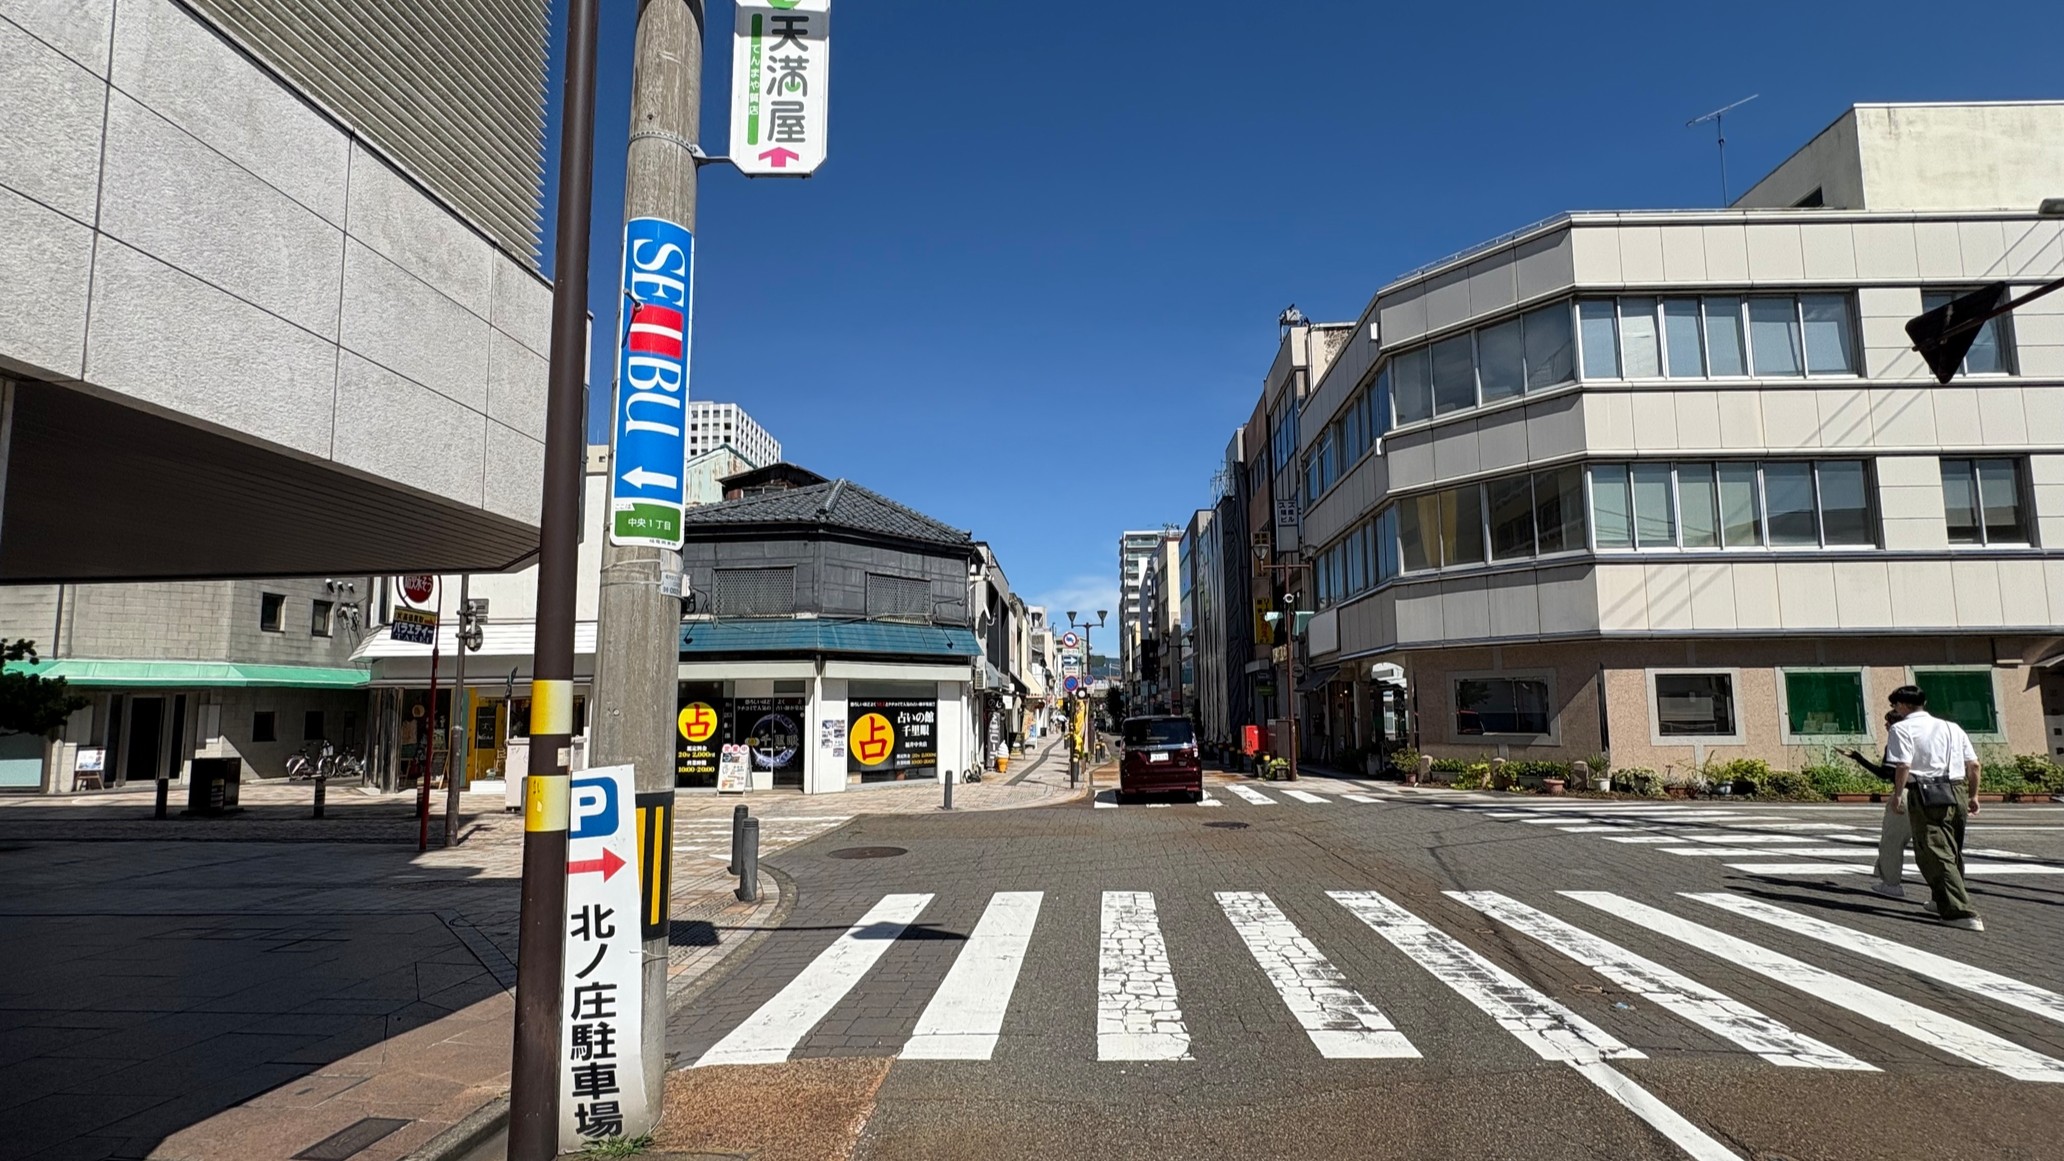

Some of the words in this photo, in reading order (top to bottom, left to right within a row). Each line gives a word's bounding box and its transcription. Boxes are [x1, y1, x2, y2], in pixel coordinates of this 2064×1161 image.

[748, 44, 761, 115] てんまや質店
[766, 15, 810, 144] 天満屋
[626, 238, 686, 438] SEIBU
[685, 703, 710, 738] 占
[859, 715, 888, 761] 占
[897, 711, 935, 724] 占いの館
[901, 724, 930, 737] 千里眼
[571, 785, 608, 832] P
[570, 904, 624, 1138] 北ノ庄駐車場
